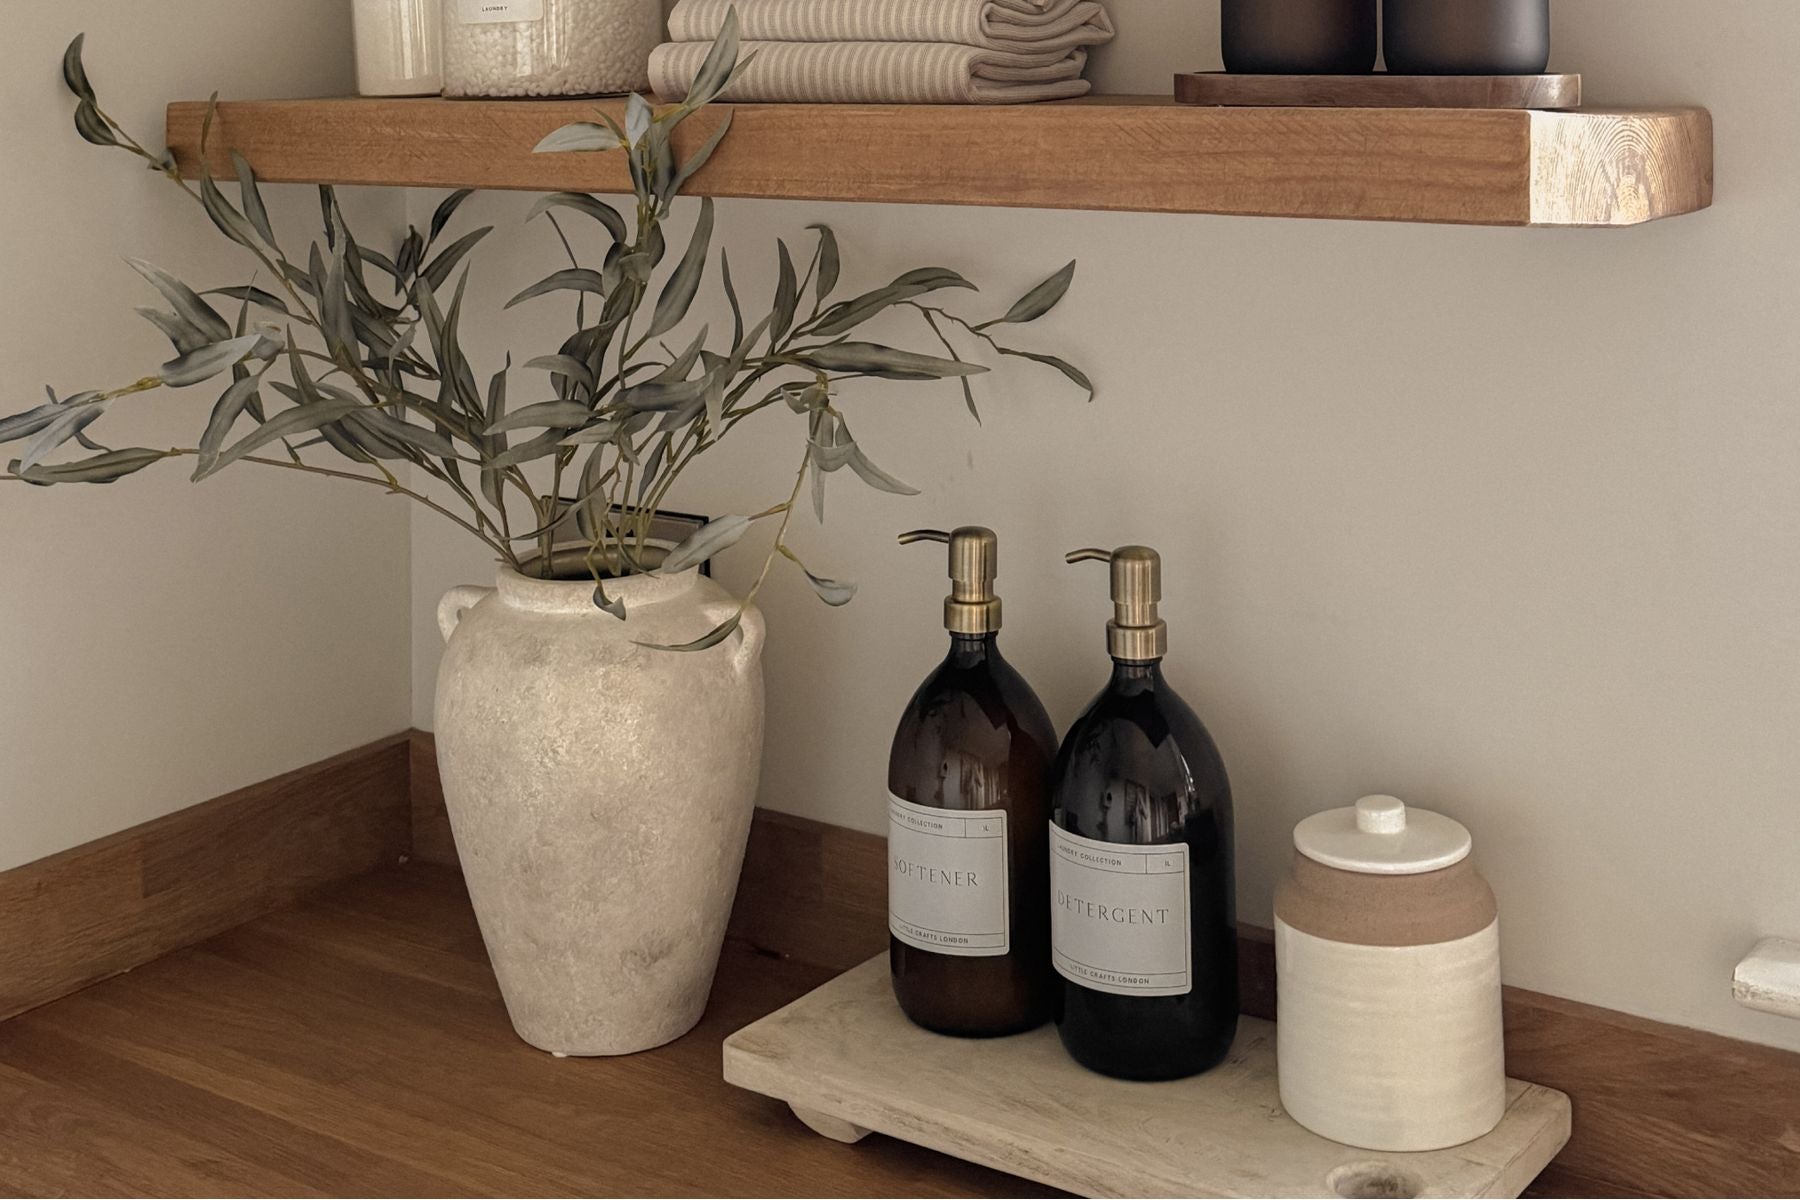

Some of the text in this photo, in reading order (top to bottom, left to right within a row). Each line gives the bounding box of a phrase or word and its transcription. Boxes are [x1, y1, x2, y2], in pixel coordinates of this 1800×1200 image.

[907, 816, 943, 830] COLLECTION
[1080, 852, 1122, 866] COLLECTION
[1057, 889, 1170, 924] DETERGENT
[915, 930, 937, 941] CRAFTS
[939, 936, 969, 944] LONDON
[1070, 963, 1150, 985] LITTLE CRAFTS LONDON
